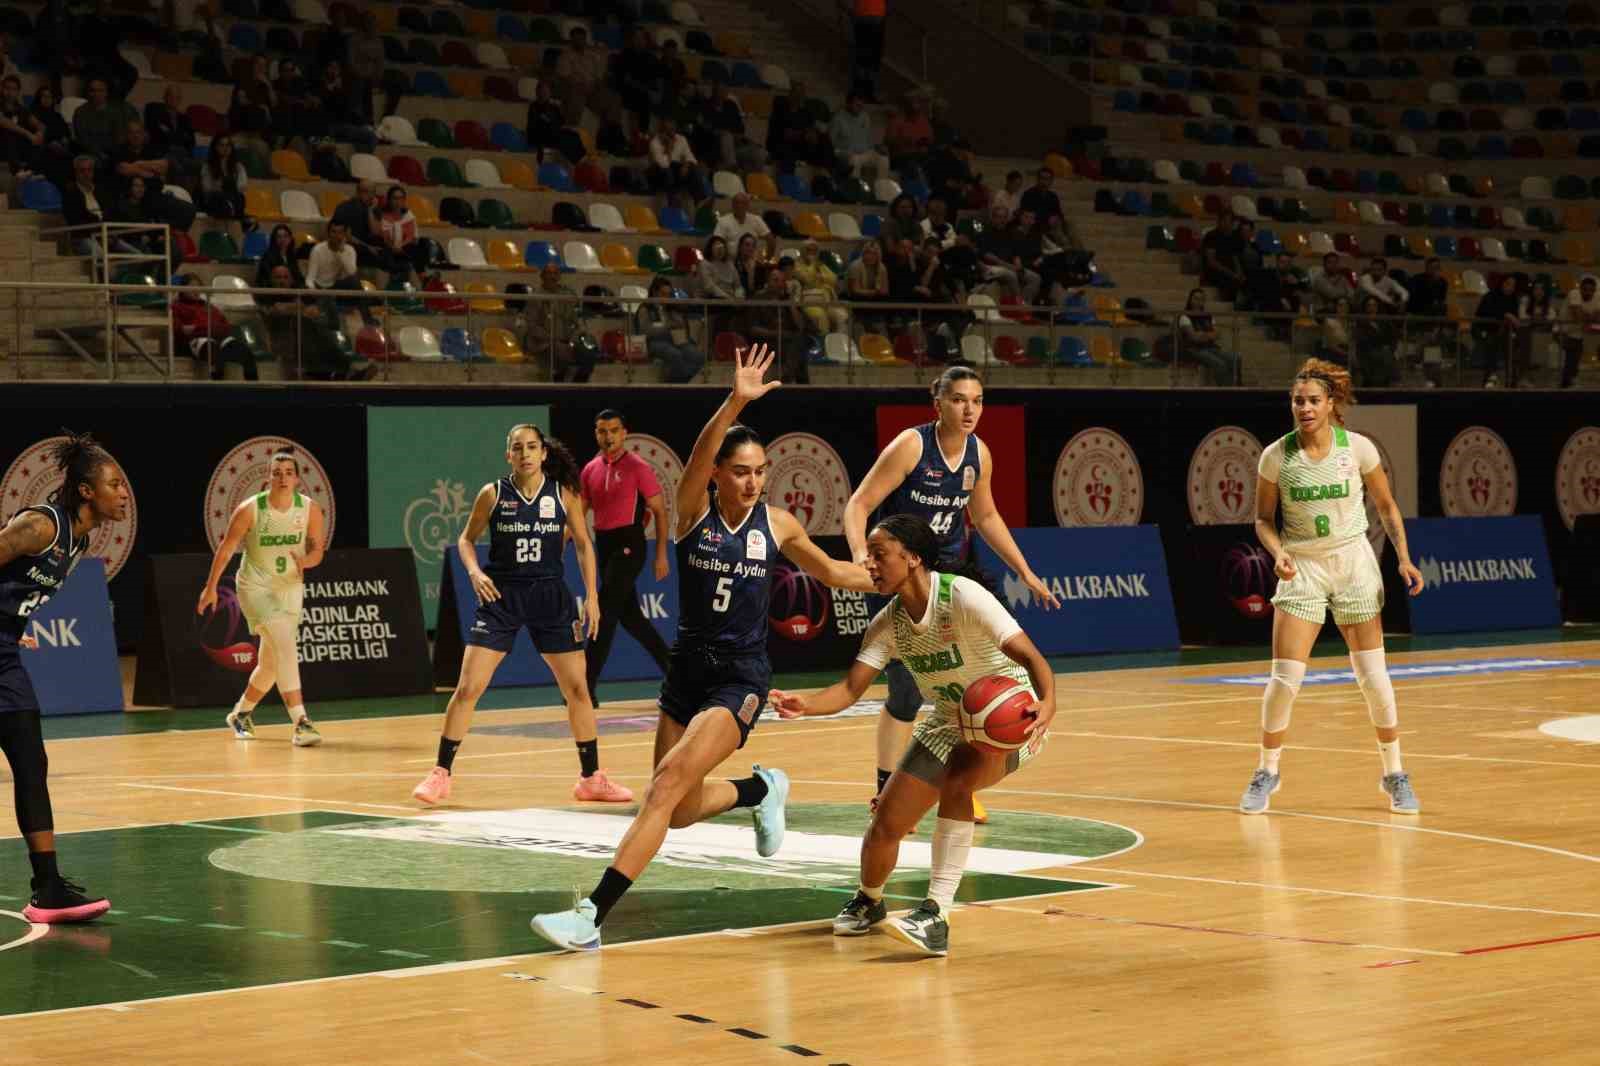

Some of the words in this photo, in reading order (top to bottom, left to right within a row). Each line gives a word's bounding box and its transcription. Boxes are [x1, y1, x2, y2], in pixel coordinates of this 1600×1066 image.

[910, 489, 951, 505] Nesibe
[496, 521, 531, 533] Nesibe
[533, 521, 560, 534] Aydın
[929, 511, 955, 534] 44
[1315, 515, 1329, 537] 8
[515, 537, 542, 563] 23
[276, 556, 287, 574] 9
[688, 552, 731, 573] Nesibe
[733, 561, 767, 578] Aydın
[1441, 557, 1536, 584] HALKBANK
[303, 580, 390, 599] HALKBANK
[712, 576, 734, 613] 5
[231, 651, 255, 664] TBF
